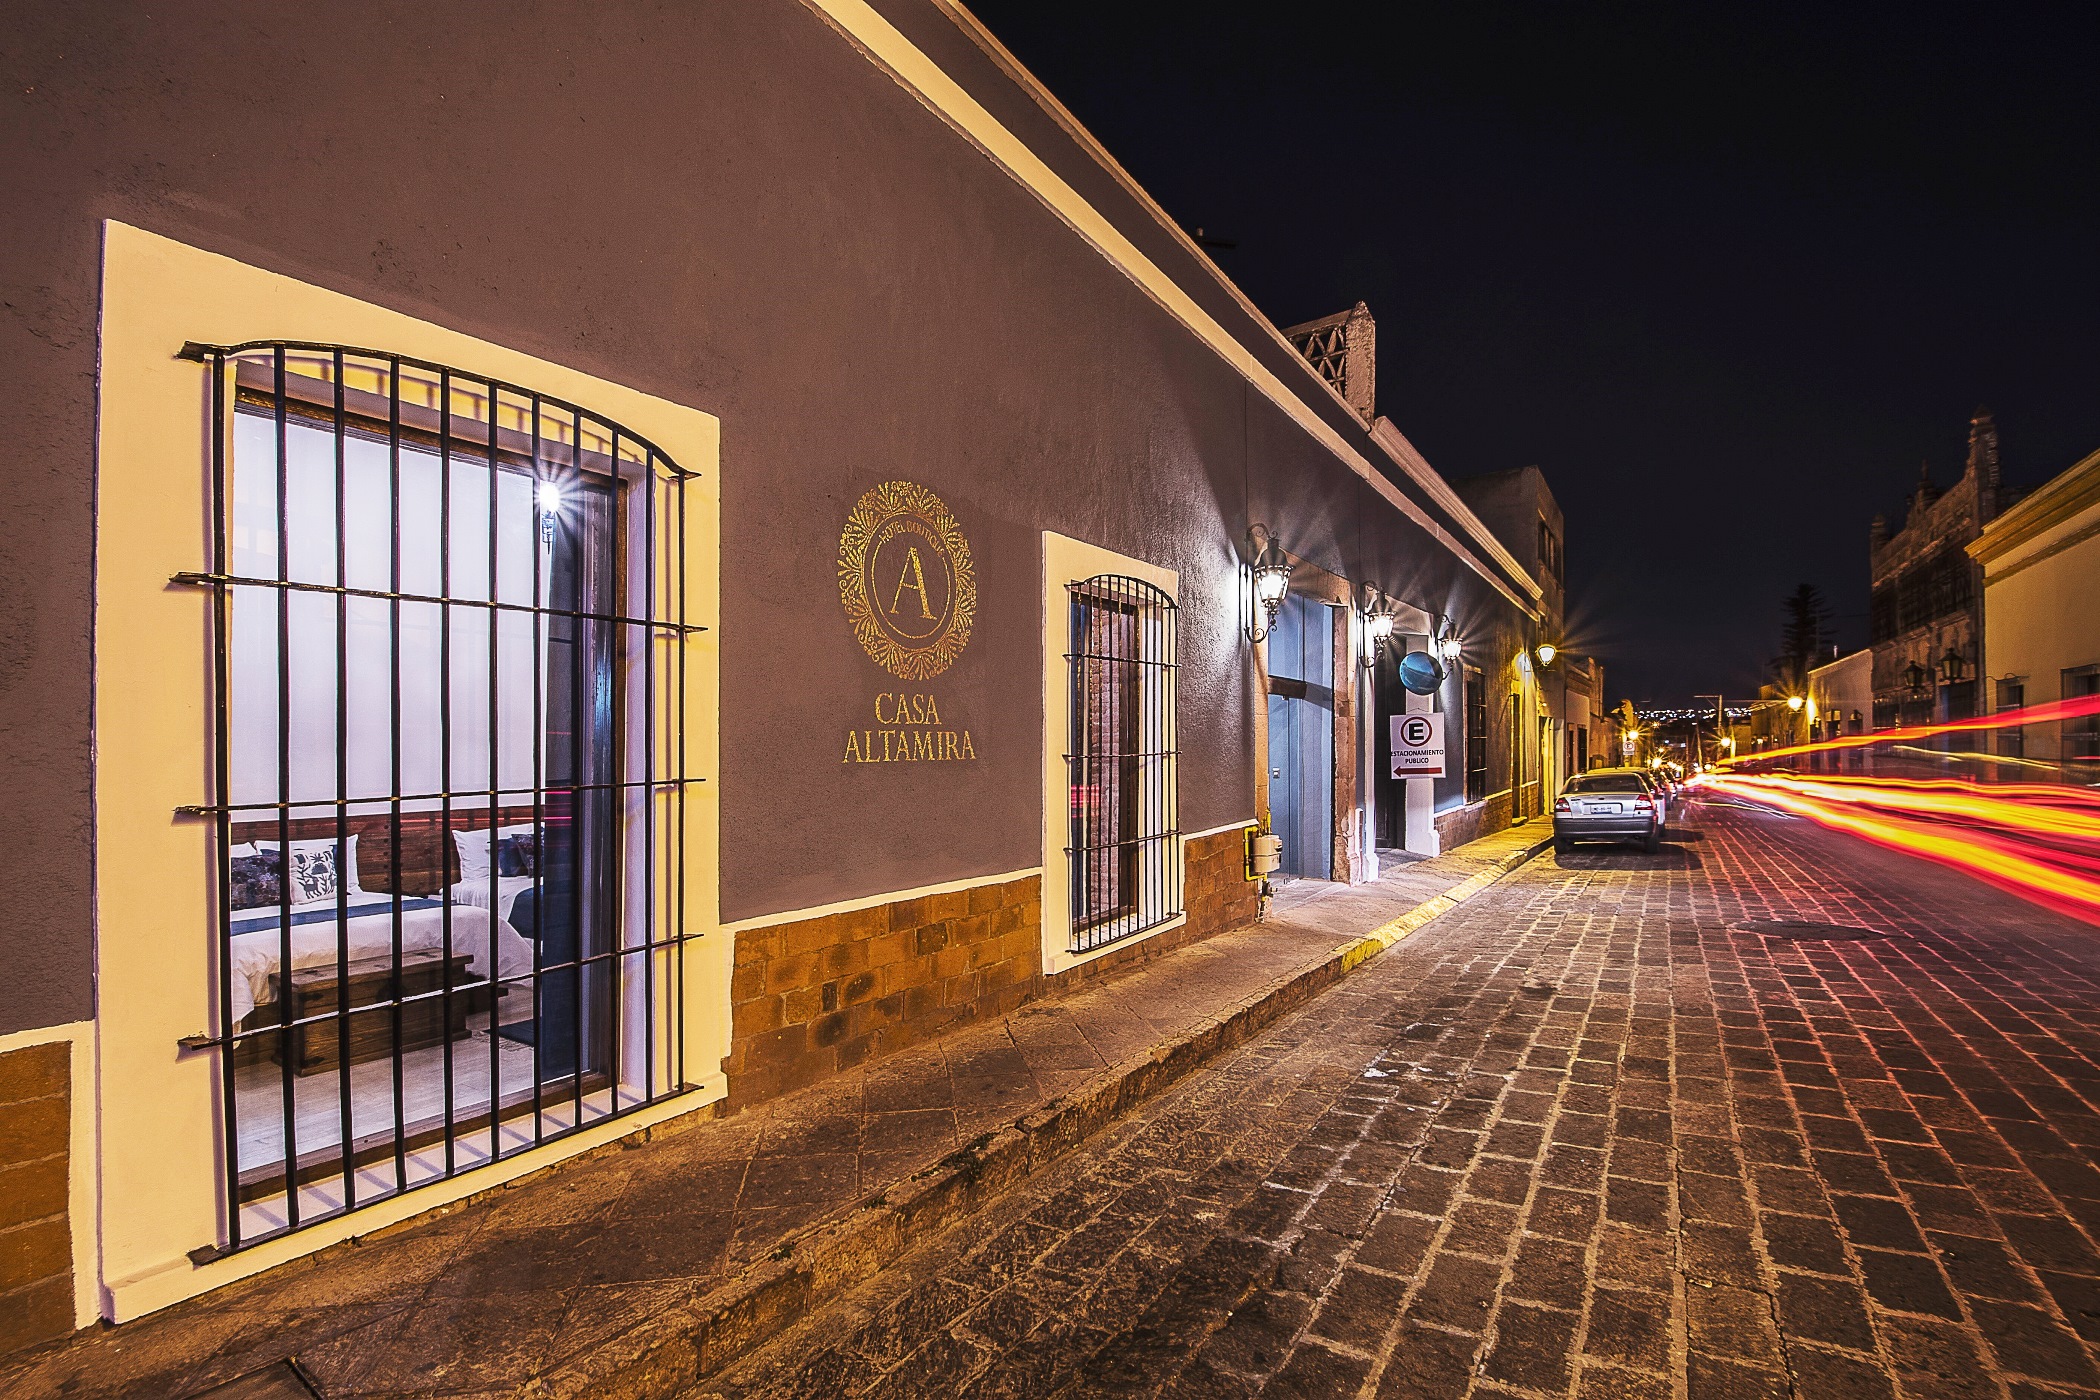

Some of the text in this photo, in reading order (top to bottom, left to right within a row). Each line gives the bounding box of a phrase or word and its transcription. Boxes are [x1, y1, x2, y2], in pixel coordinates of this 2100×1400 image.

[889, 546, 937, 620] A
[875, 692, 942, 725] CASA
[842, 730, 976, 763] ALTAMIRA
[1408, 722, 1424, 740] E
